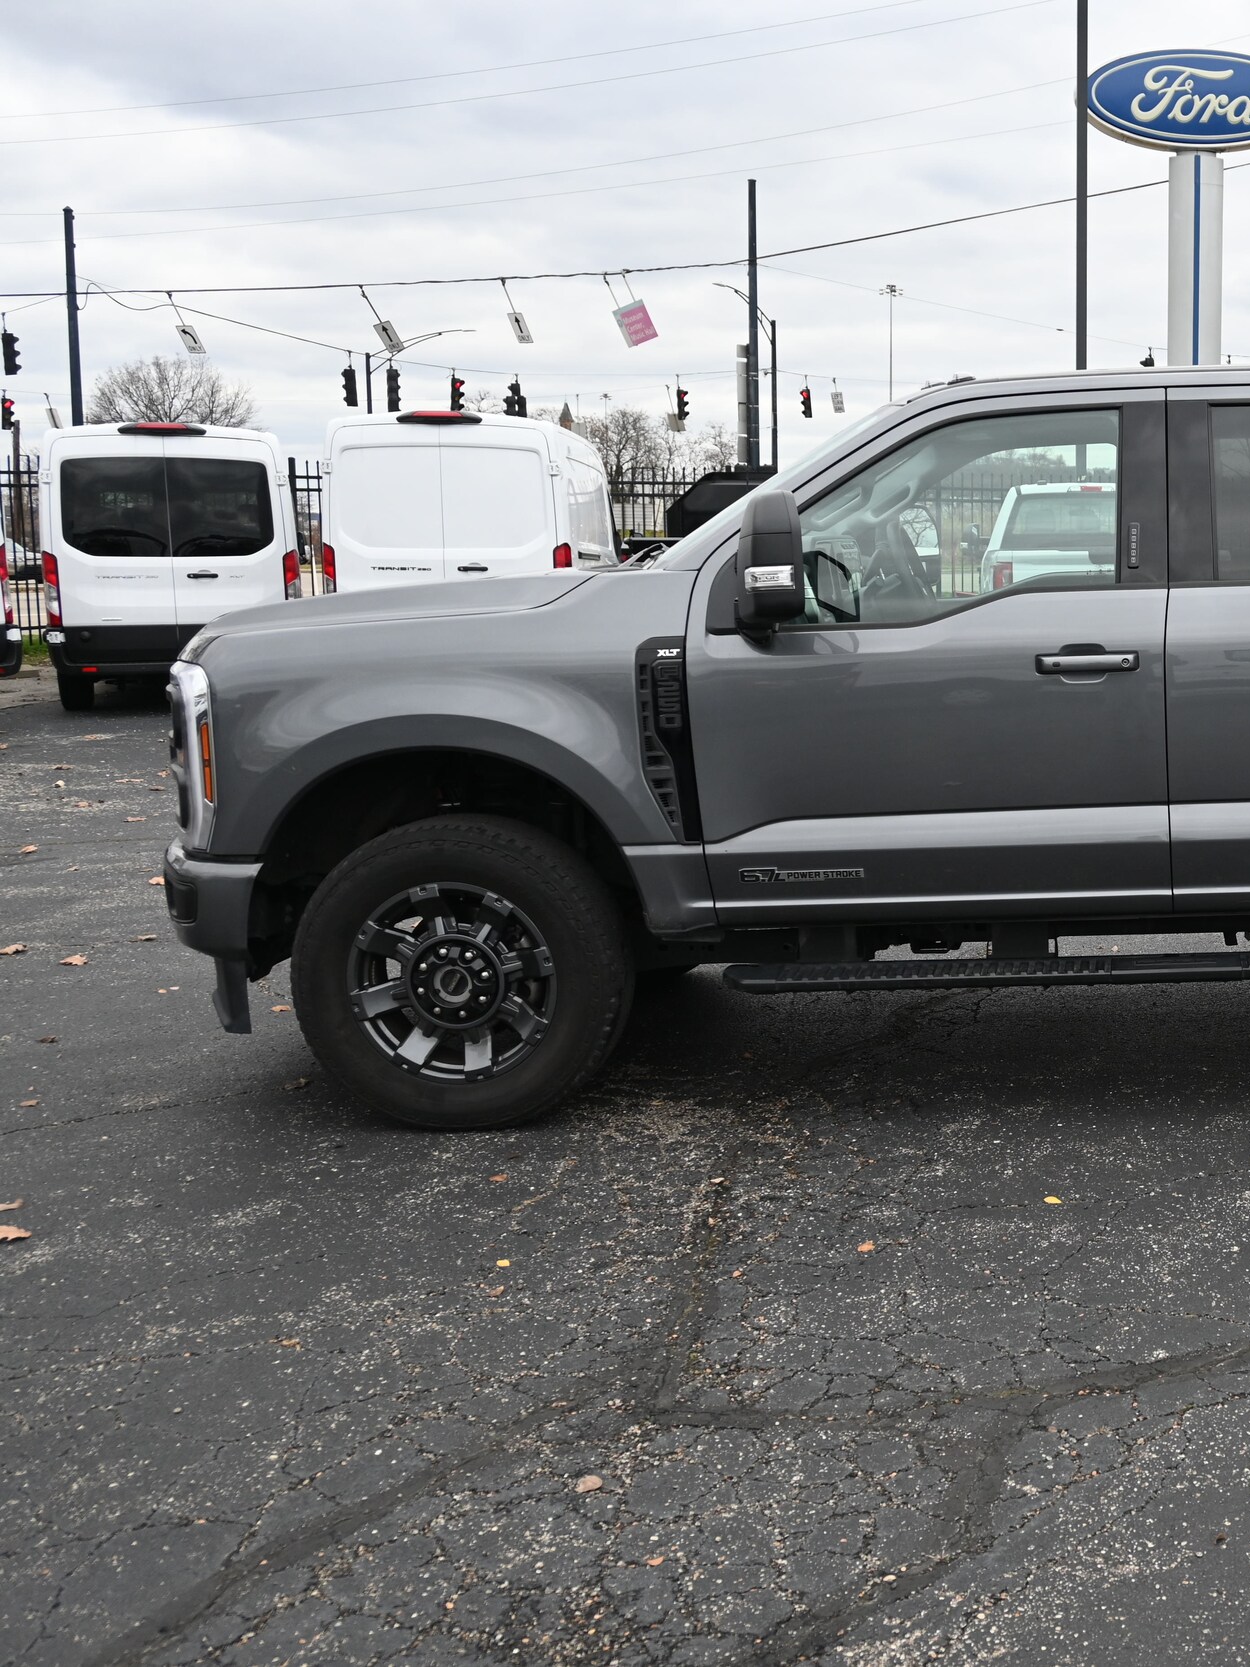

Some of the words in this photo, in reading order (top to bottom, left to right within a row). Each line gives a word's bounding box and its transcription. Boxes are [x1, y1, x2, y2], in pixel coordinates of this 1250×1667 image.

[657, 649, 680, 657] XLT
[739, 867, 786, 882] 6.7L
[786, 871, 821, 880] POWER
[823, 869, 862, 878] STROKE
